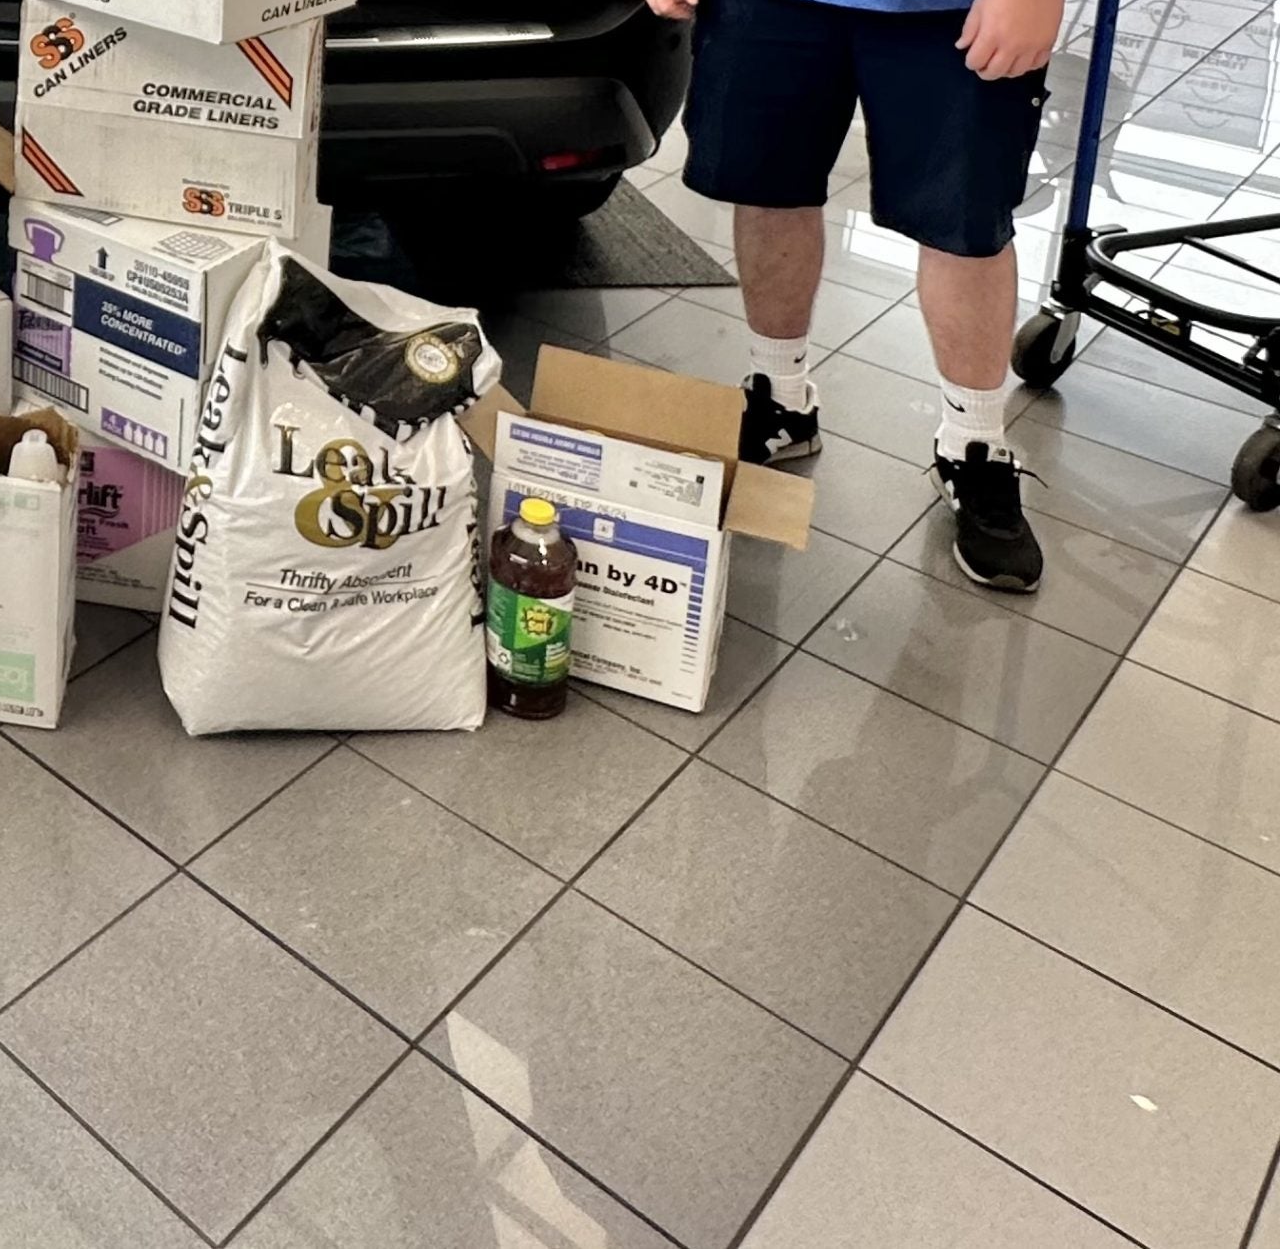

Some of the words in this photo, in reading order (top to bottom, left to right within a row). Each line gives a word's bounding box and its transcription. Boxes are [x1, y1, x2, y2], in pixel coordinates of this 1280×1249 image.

[262, 3, 290, 22] CAN
[33, 71, 67, 98] CAN
[69, 26, 128, 75] LINERS
[142, 82, 277, 110] COMMERCIAL
[133, 99, 201, 119] GRADE
[207, 110, 279, 131] LINERS
[228, 202, 270, 218] TRIPLE
[274, 209, 282, 220] S
[101, 301, 121, 317] 35%
[122, 309, 153, 330] MORE
[192, 338, 249, 467] Leak
[273, 424, 415, 486] Leak
[328, 486, 447, 550] Spill
[168, 504, 209, 629] Spill
[607, 564, 636, 587] by
[280, 569, 338, 594] Thrifty
[243, 591, 272, 607] For
[274, 597, 282, 609] a
[288, 598, 327, 612] Clean
[371, 586, 439, 604] Workplace
[603, 586, 655, 606] Disinfectant
